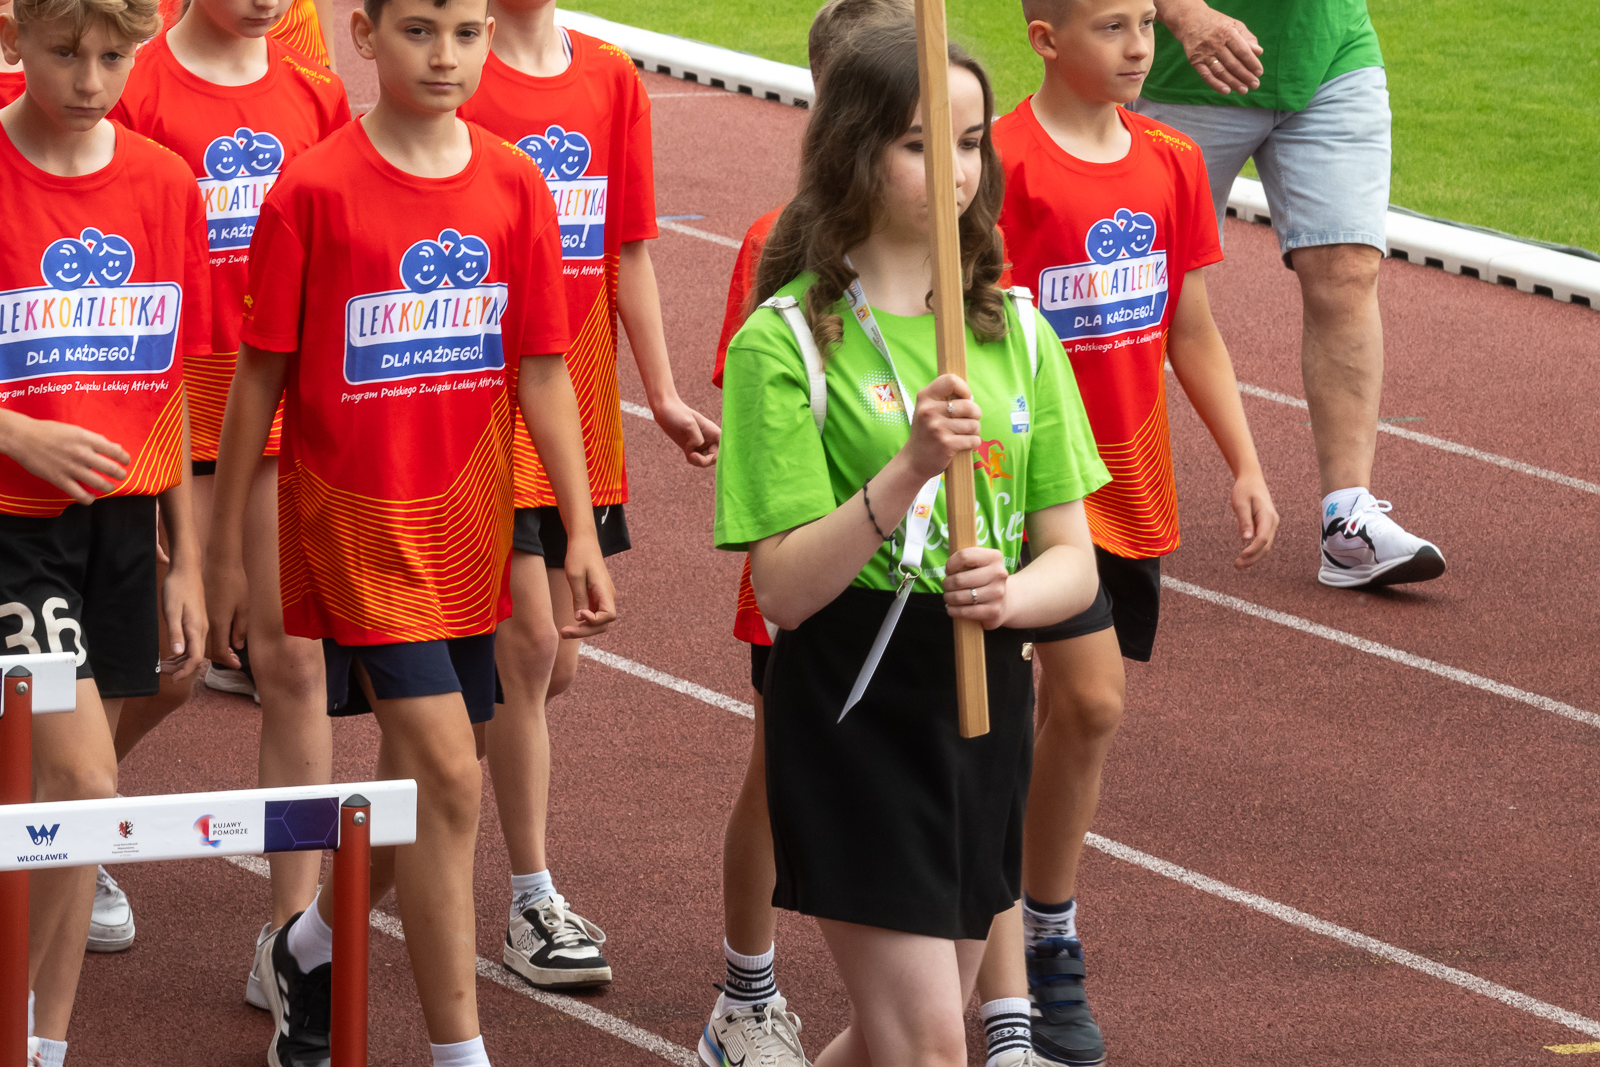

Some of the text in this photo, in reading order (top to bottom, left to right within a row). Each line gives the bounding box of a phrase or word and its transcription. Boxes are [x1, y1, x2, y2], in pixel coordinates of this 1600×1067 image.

[1074, 314, 1102, 329] DLA
[26, 335, 140, 366] DLA KAŻDEGO!
[381, 333, 485, 369] DLA KAŻDEGO!
[1075, 342, 1113, 354] Polskiego
[27, 382, 72, 395] Polskiego
[74, 380, 101, 393] Związku
[103, 380, 130, 395] Lekkiej
[131, 379, 169, 393] Atletyki
[341, 378, 477, 404] Program Polskiego Związku Lekkiej
[212, 821, 242, 829] KUJAWY
[212, 828, 248, 836] POMORZE
[17, 853, 68, 863] WŁOCŁAWEK
